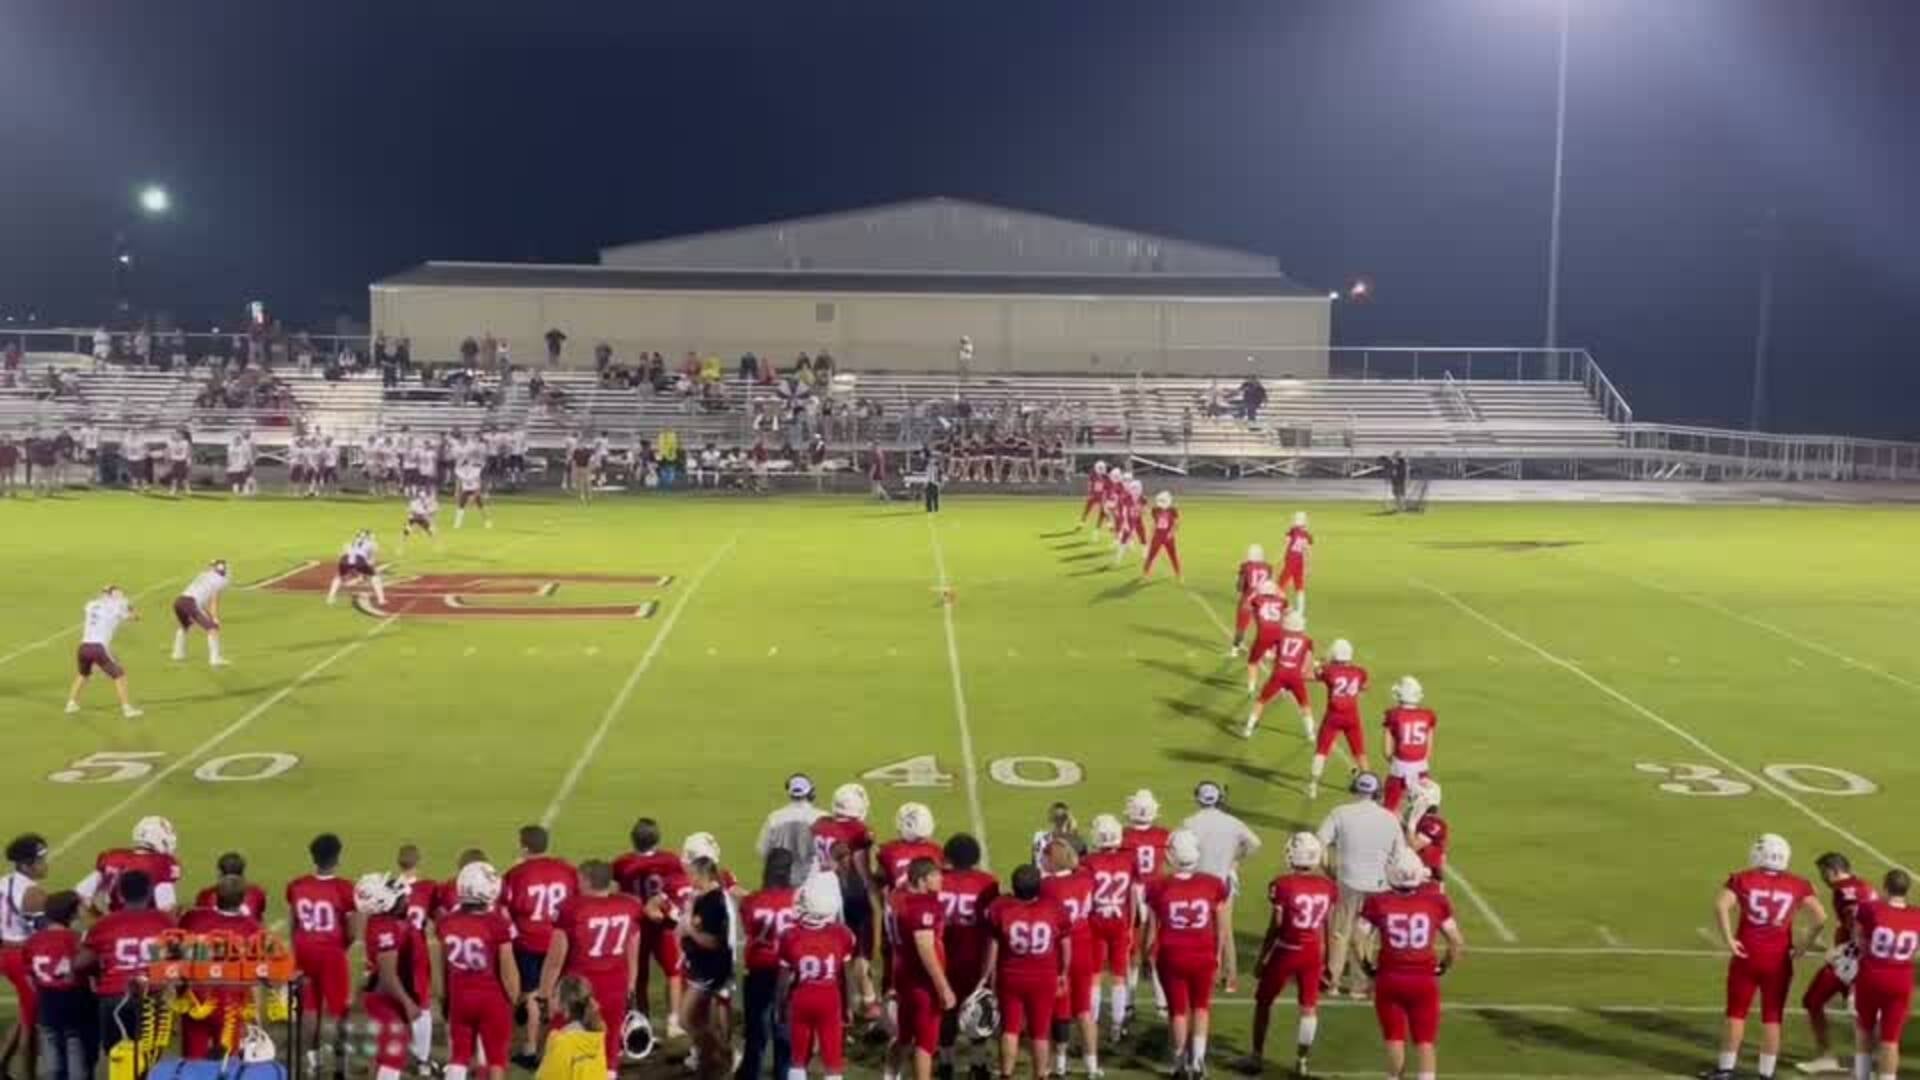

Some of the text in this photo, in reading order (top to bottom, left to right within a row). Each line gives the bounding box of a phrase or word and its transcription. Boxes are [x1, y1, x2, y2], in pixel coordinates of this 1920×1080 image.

[1258, 600, 1281, 621] 45
[1281, 637, 1304, 658] 17
[1332, 676, 1360, 697] 24
[1401, 721, 1428, 746] 15
[47, 751, 301, 784] 50
[862, 754, 1083, 787] 40
[1634, 762, 1878, 795] 30
[1136, 845, 1155, 874] 8
[527, 882, 567, 922] 78
[1094, 871, 1131, 904] 22
[296, 898, 335, 932] 60
[937, 891, 977, 925] 75
[1169, 899, 1210, 929] 53
[1293, 893, 1330, 929] 37
[1748, 888, 1793, 926] 57
[587, 914, 630, 958] 77
[1386, 912, 1430, 949] 58
[1871, 925, 1918, 961] 80
[445, 934, 487, 970] 26
